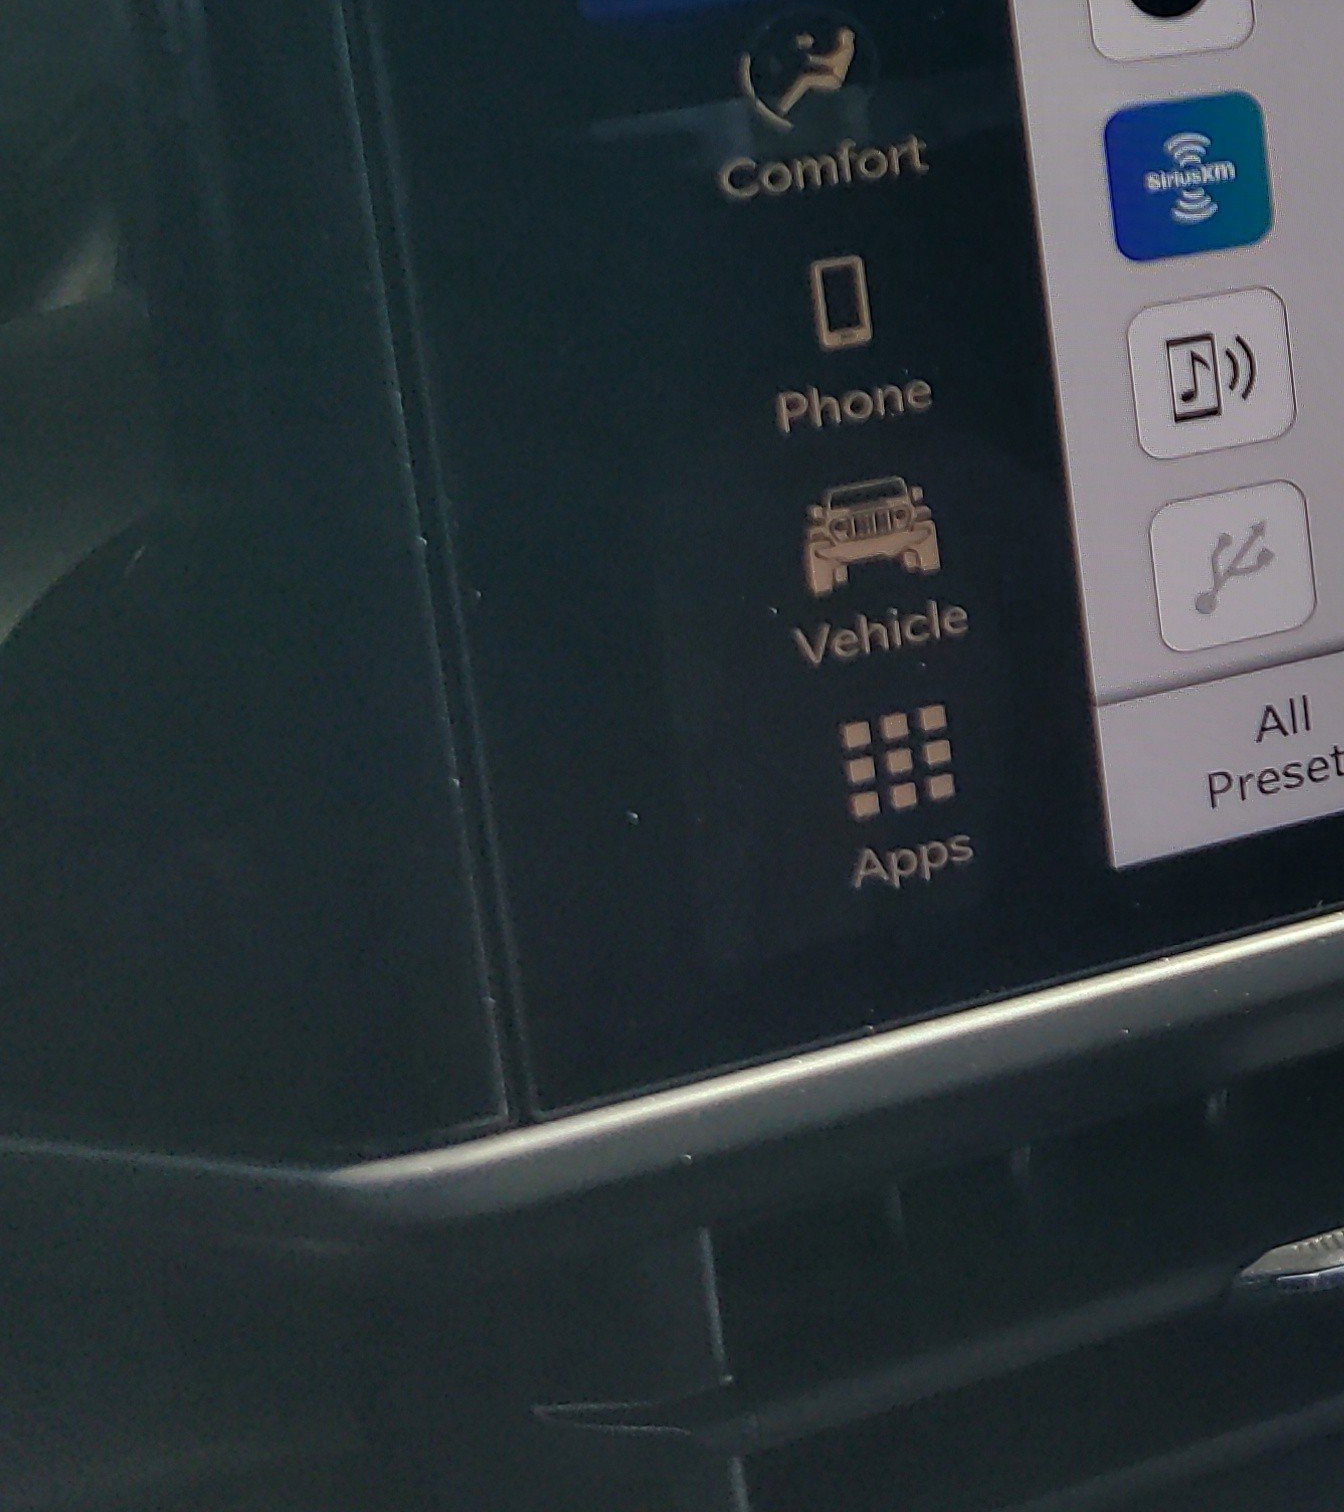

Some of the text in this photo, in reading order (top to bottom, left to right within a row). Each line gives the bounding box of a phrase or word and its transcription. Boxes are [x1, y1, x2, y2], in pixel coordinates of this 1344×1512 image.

[717, 134, 931, 198] Comfort
[776, 376, 934, 435] Phone
[794, 599, 970, 669] Vehicle
[1255, 695, 1313, 744] All
[853, 830, 974, 888] Apps
